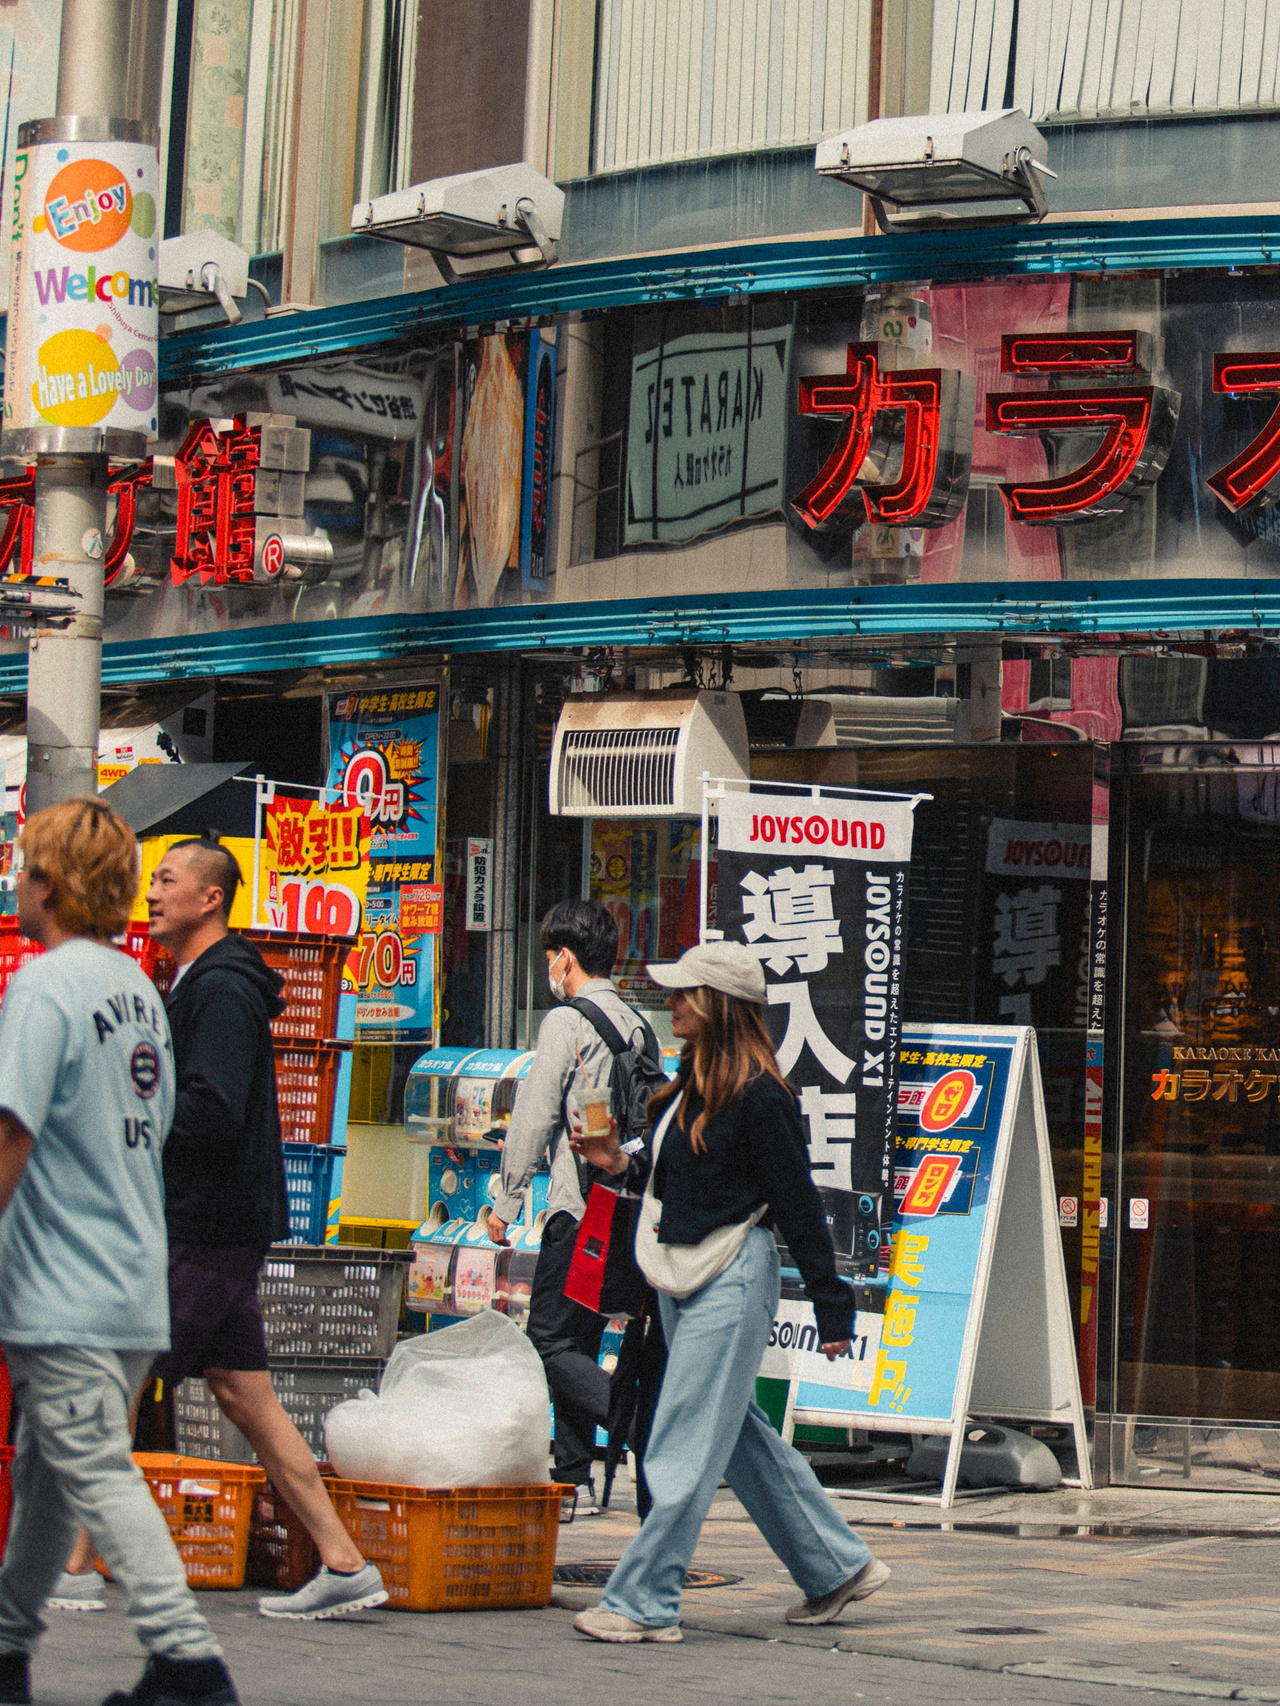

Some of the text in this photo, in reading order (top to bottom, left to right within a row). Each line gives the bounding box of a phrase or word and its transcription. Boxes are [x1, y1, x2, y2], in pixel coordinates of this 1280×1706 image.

[46, 183, 127, 240] Enjoy
[108, 302, 133, 333] Shibuya
[38, 364, 77, 410] Have
[77, 372, 89, 394] a
[88, 362, 133, 396] Lovely
[750, 814, 886, 850] JOYSOUND
[365, 862, 431, 884] ・専門学生限定
[864, 871, 892, 1041] JOYSOUND
[1173, 1047, 1252, 1062] KARAOKE
[124, 1116, 164, 1150] US
